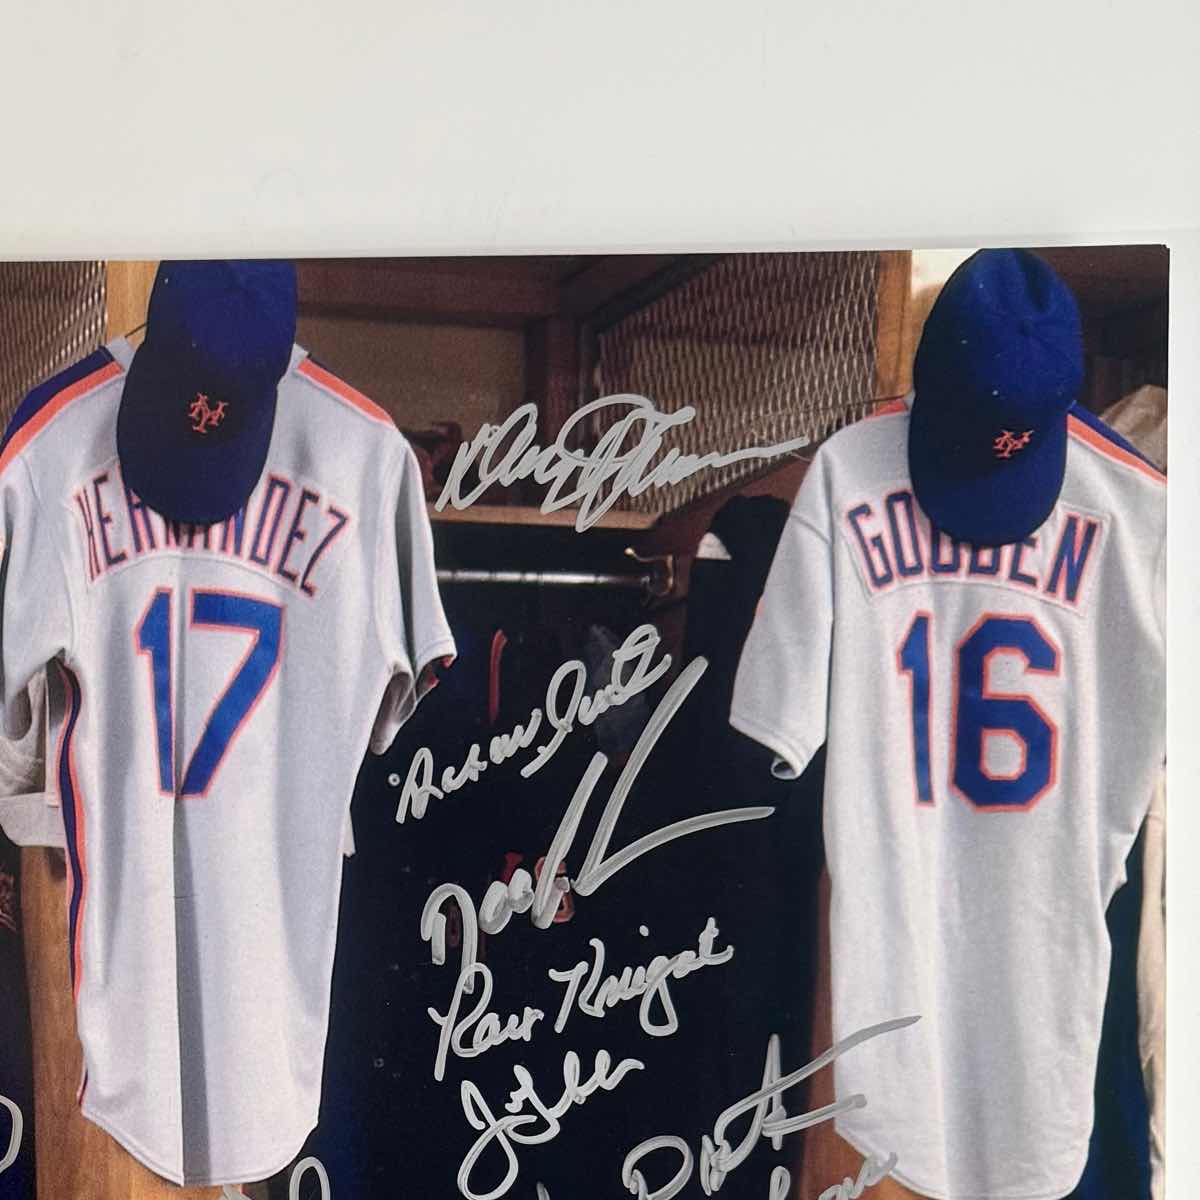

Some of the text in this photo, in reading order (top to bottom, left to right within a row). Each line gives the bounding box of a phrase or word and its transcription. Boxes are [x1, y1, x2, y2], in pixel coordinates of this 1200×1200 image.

[74, 472, 350, 598] HERDEZ
[135, 586, 286, 800] 17
[897, 609, 1061, 813] 16
